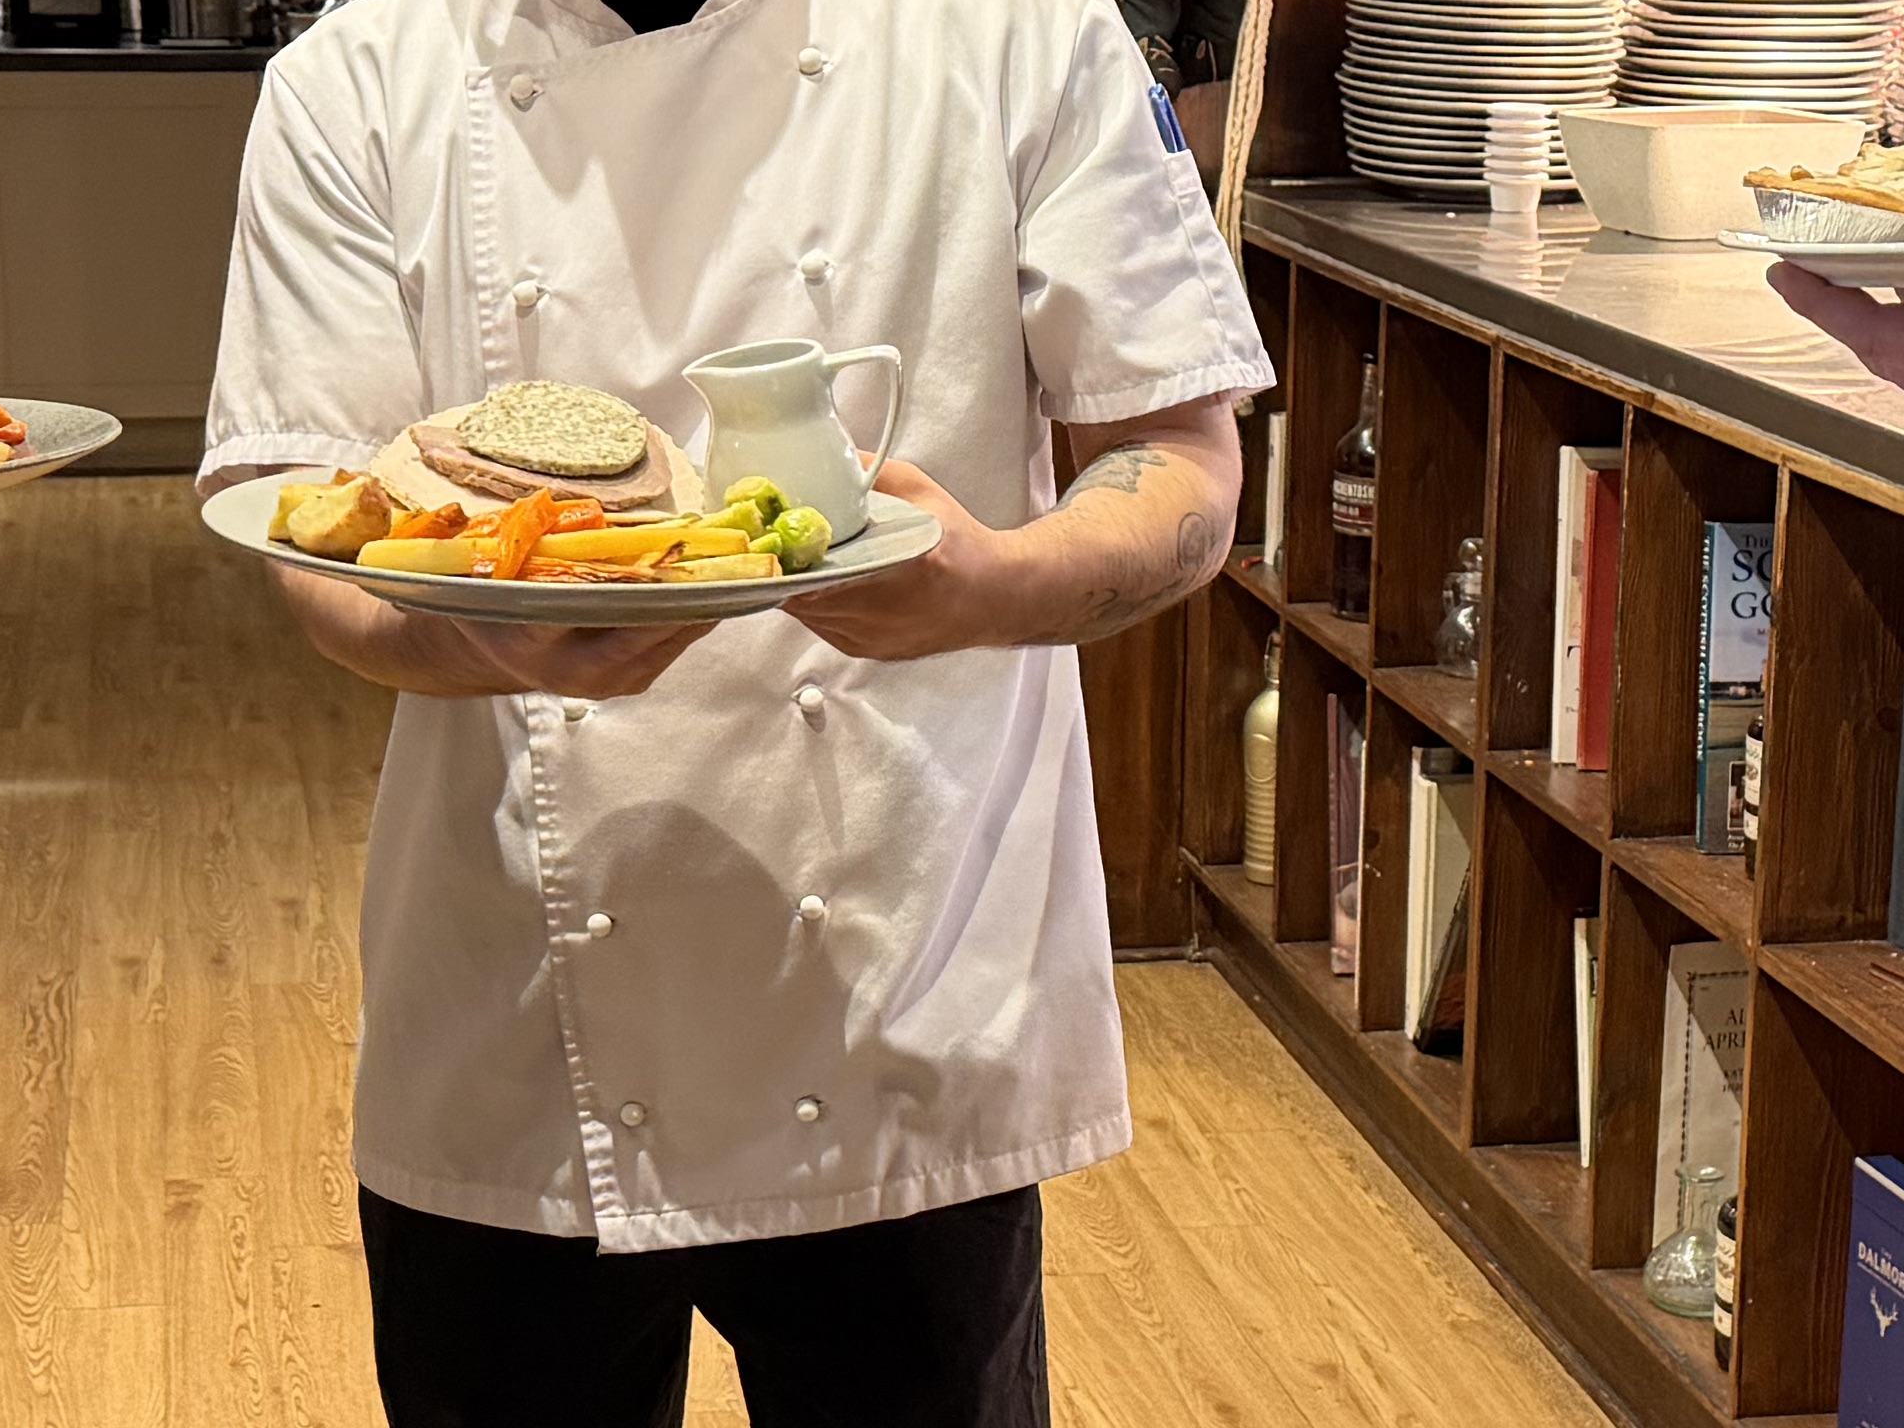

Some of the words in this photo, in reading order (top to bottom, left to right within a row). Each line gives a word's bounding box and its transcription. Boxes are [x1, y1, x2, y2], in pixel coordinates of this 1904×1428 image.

[1699, 574, 1709, 658] SCOTTISH
[1698, 662, 1707, 709] GOLF
[1696, 712, 1705, 761] BOOK
